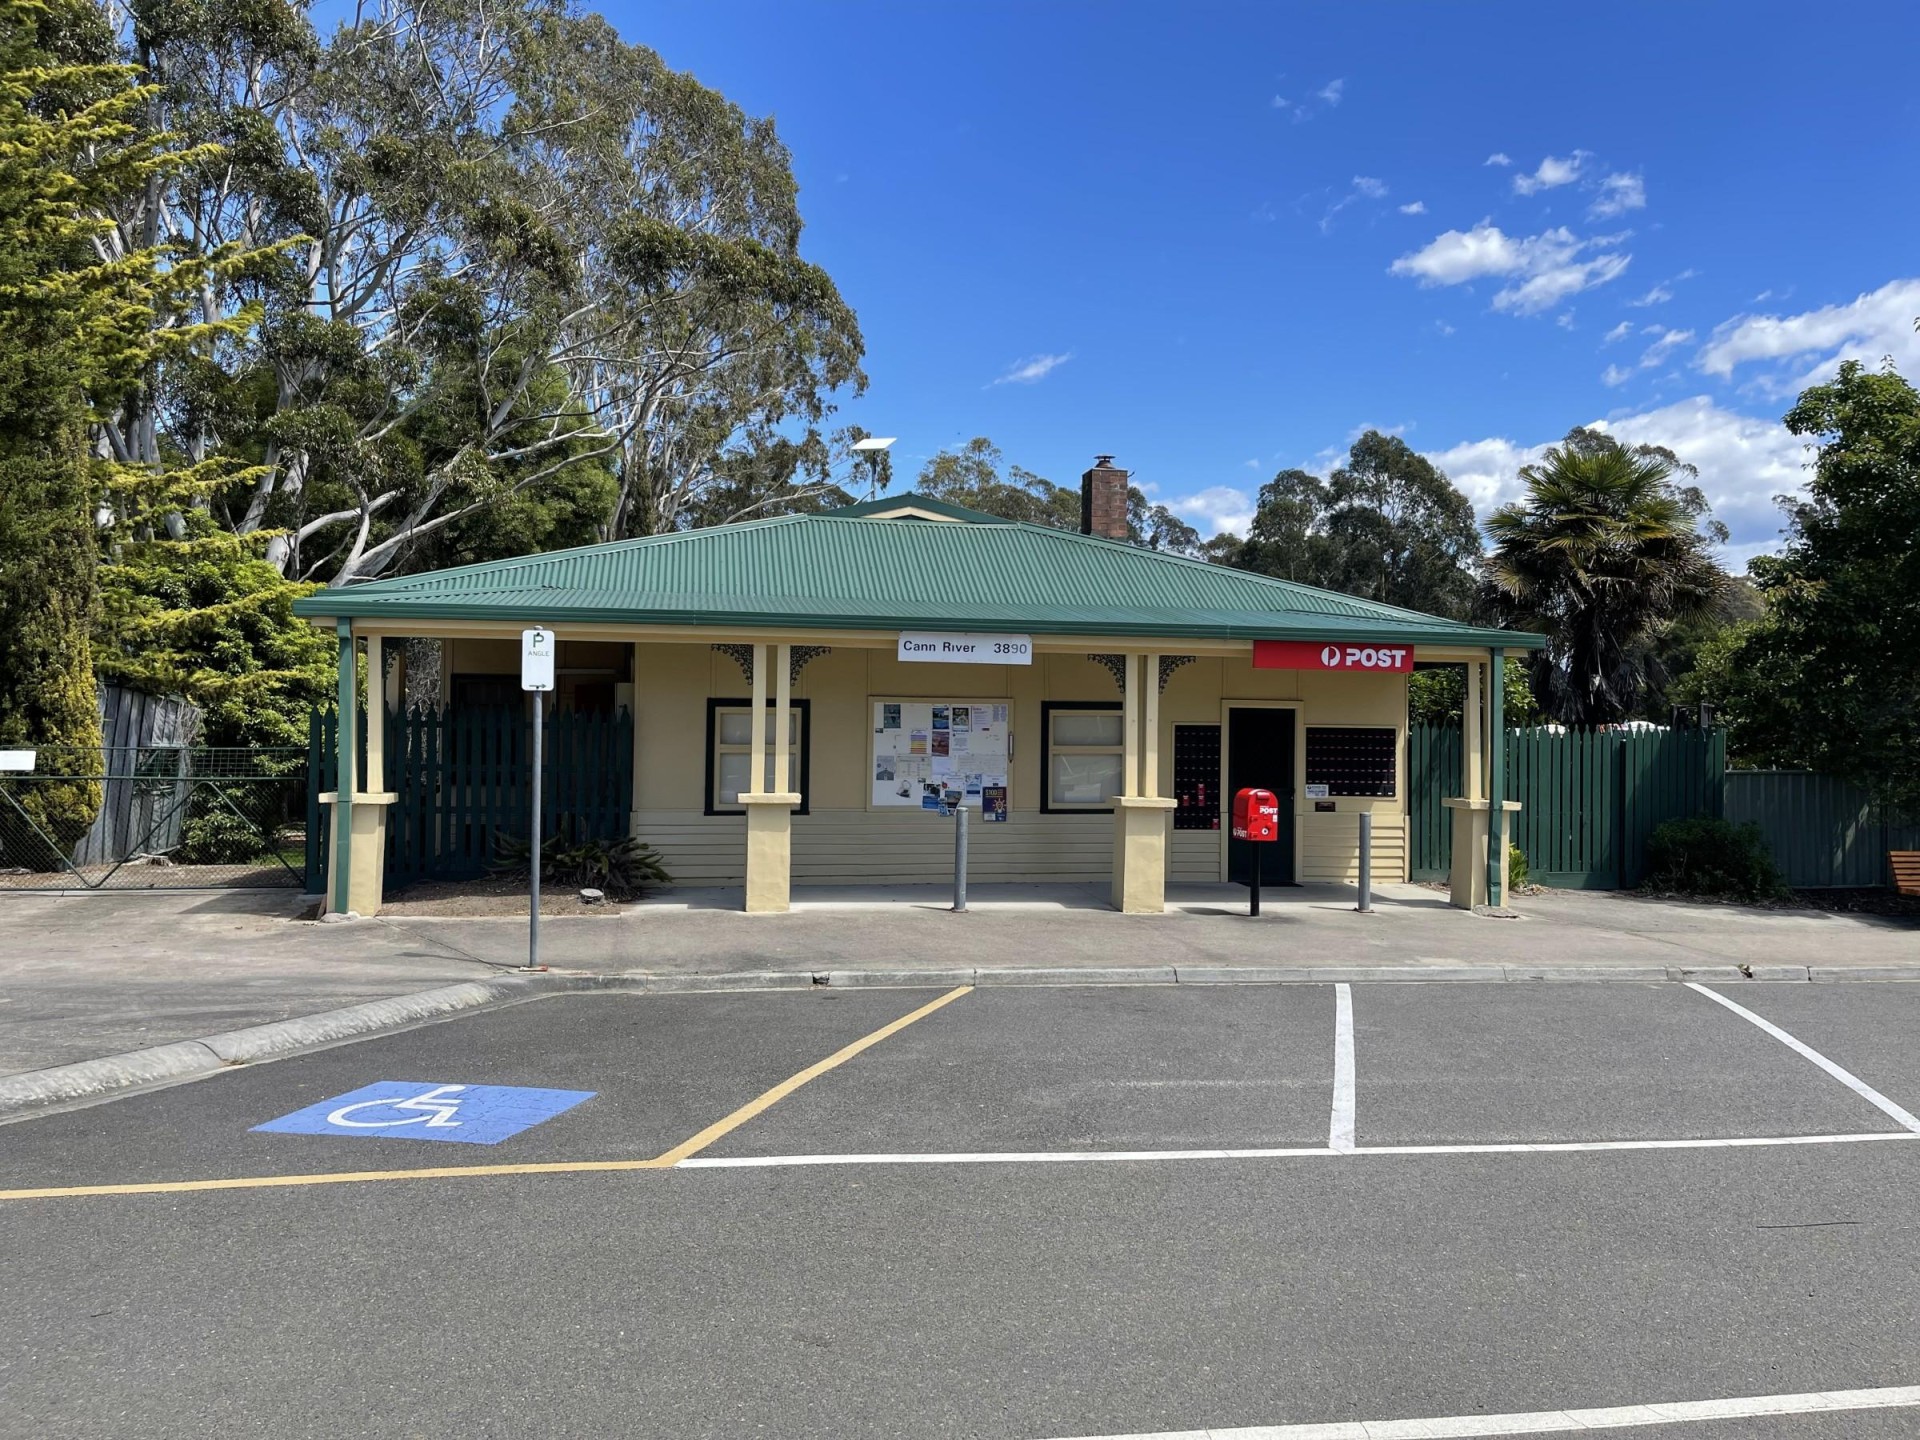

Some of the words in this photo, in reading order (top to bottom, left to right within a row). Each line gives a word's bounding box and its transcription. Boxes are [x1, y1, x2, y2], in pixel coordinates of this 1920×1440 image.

[533, 634, 545, 648] P
[903, 640, 936, 652] Cann
[942, 641, 977, 653] River
[993, 643, 1028, 655] 3890
[1345, 648, 1406, 668] POST
[1259, 807, 1278, 815] POST
